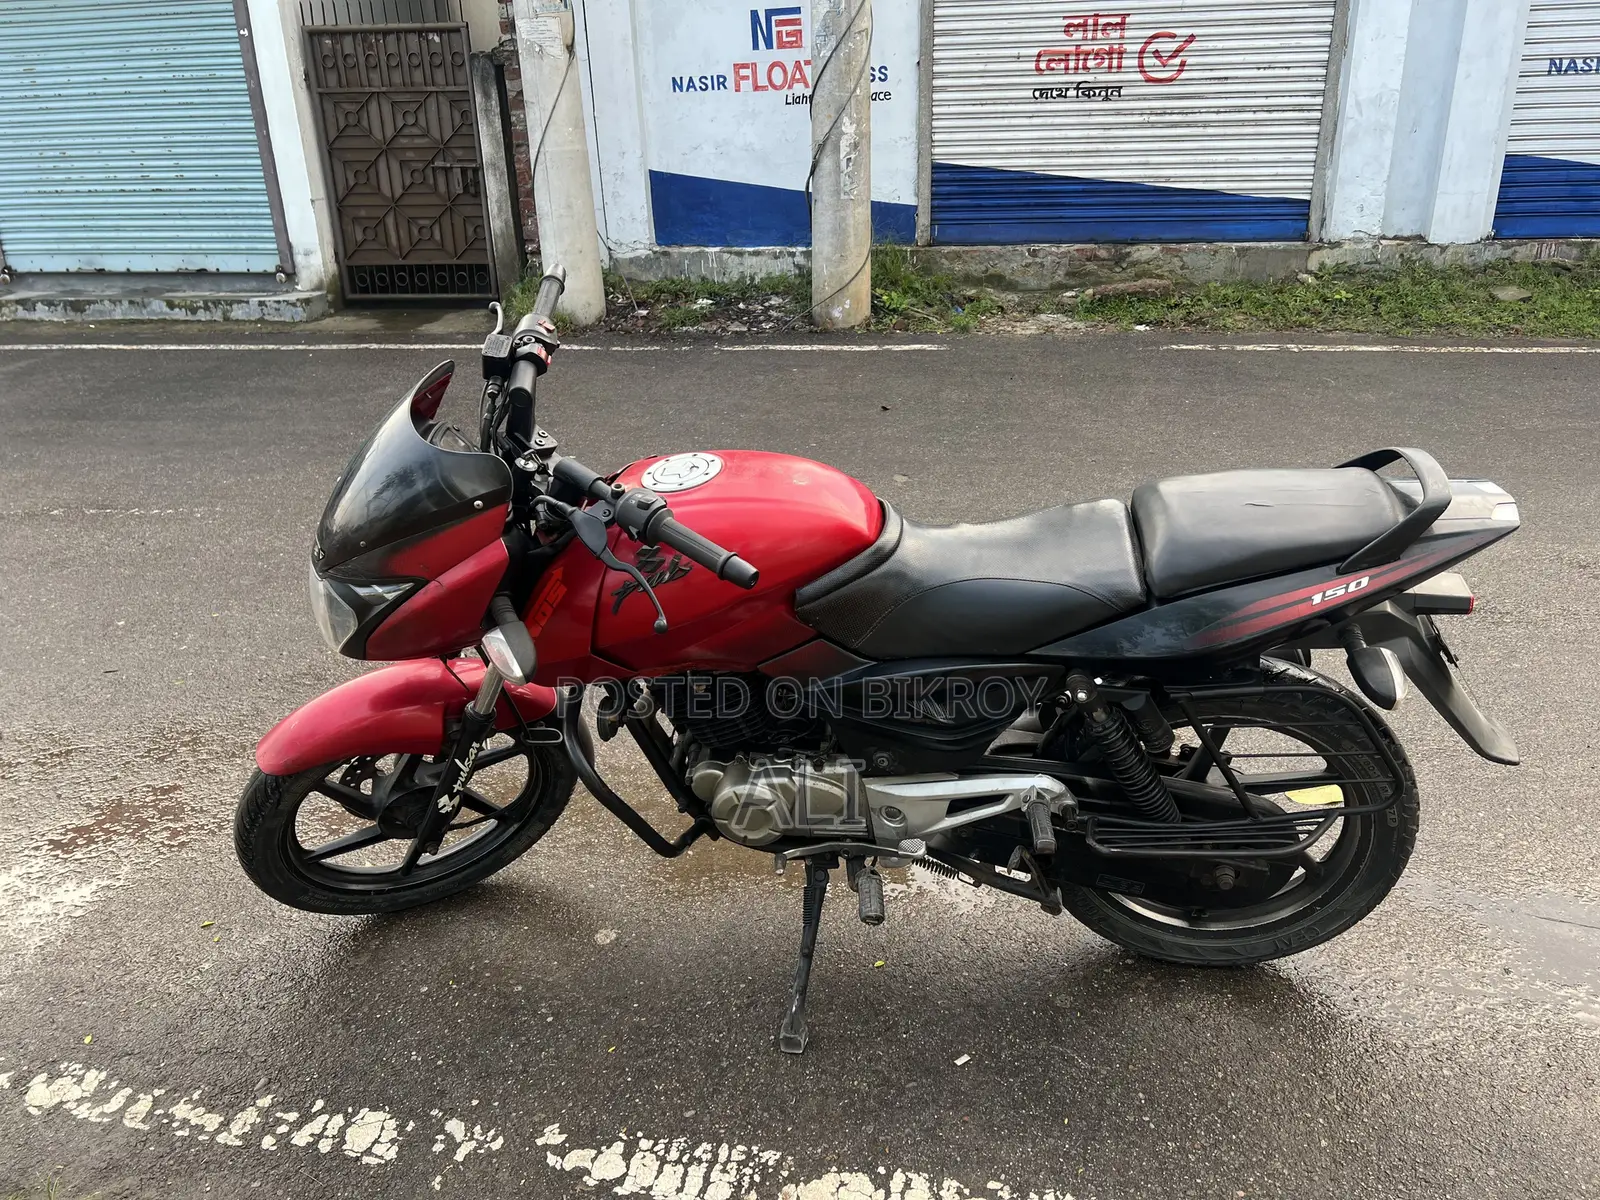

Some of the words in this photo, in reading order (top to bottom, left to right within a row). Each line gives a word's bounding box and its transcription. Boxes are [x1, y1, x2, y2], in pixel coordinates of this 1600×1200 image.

[1062, 13, 1131, 41] লাল
[671, 74, 728, 93] NASIR
[1032, 86, 1070, 100] দেখে
[1311, 575, 1370, 606] 150
